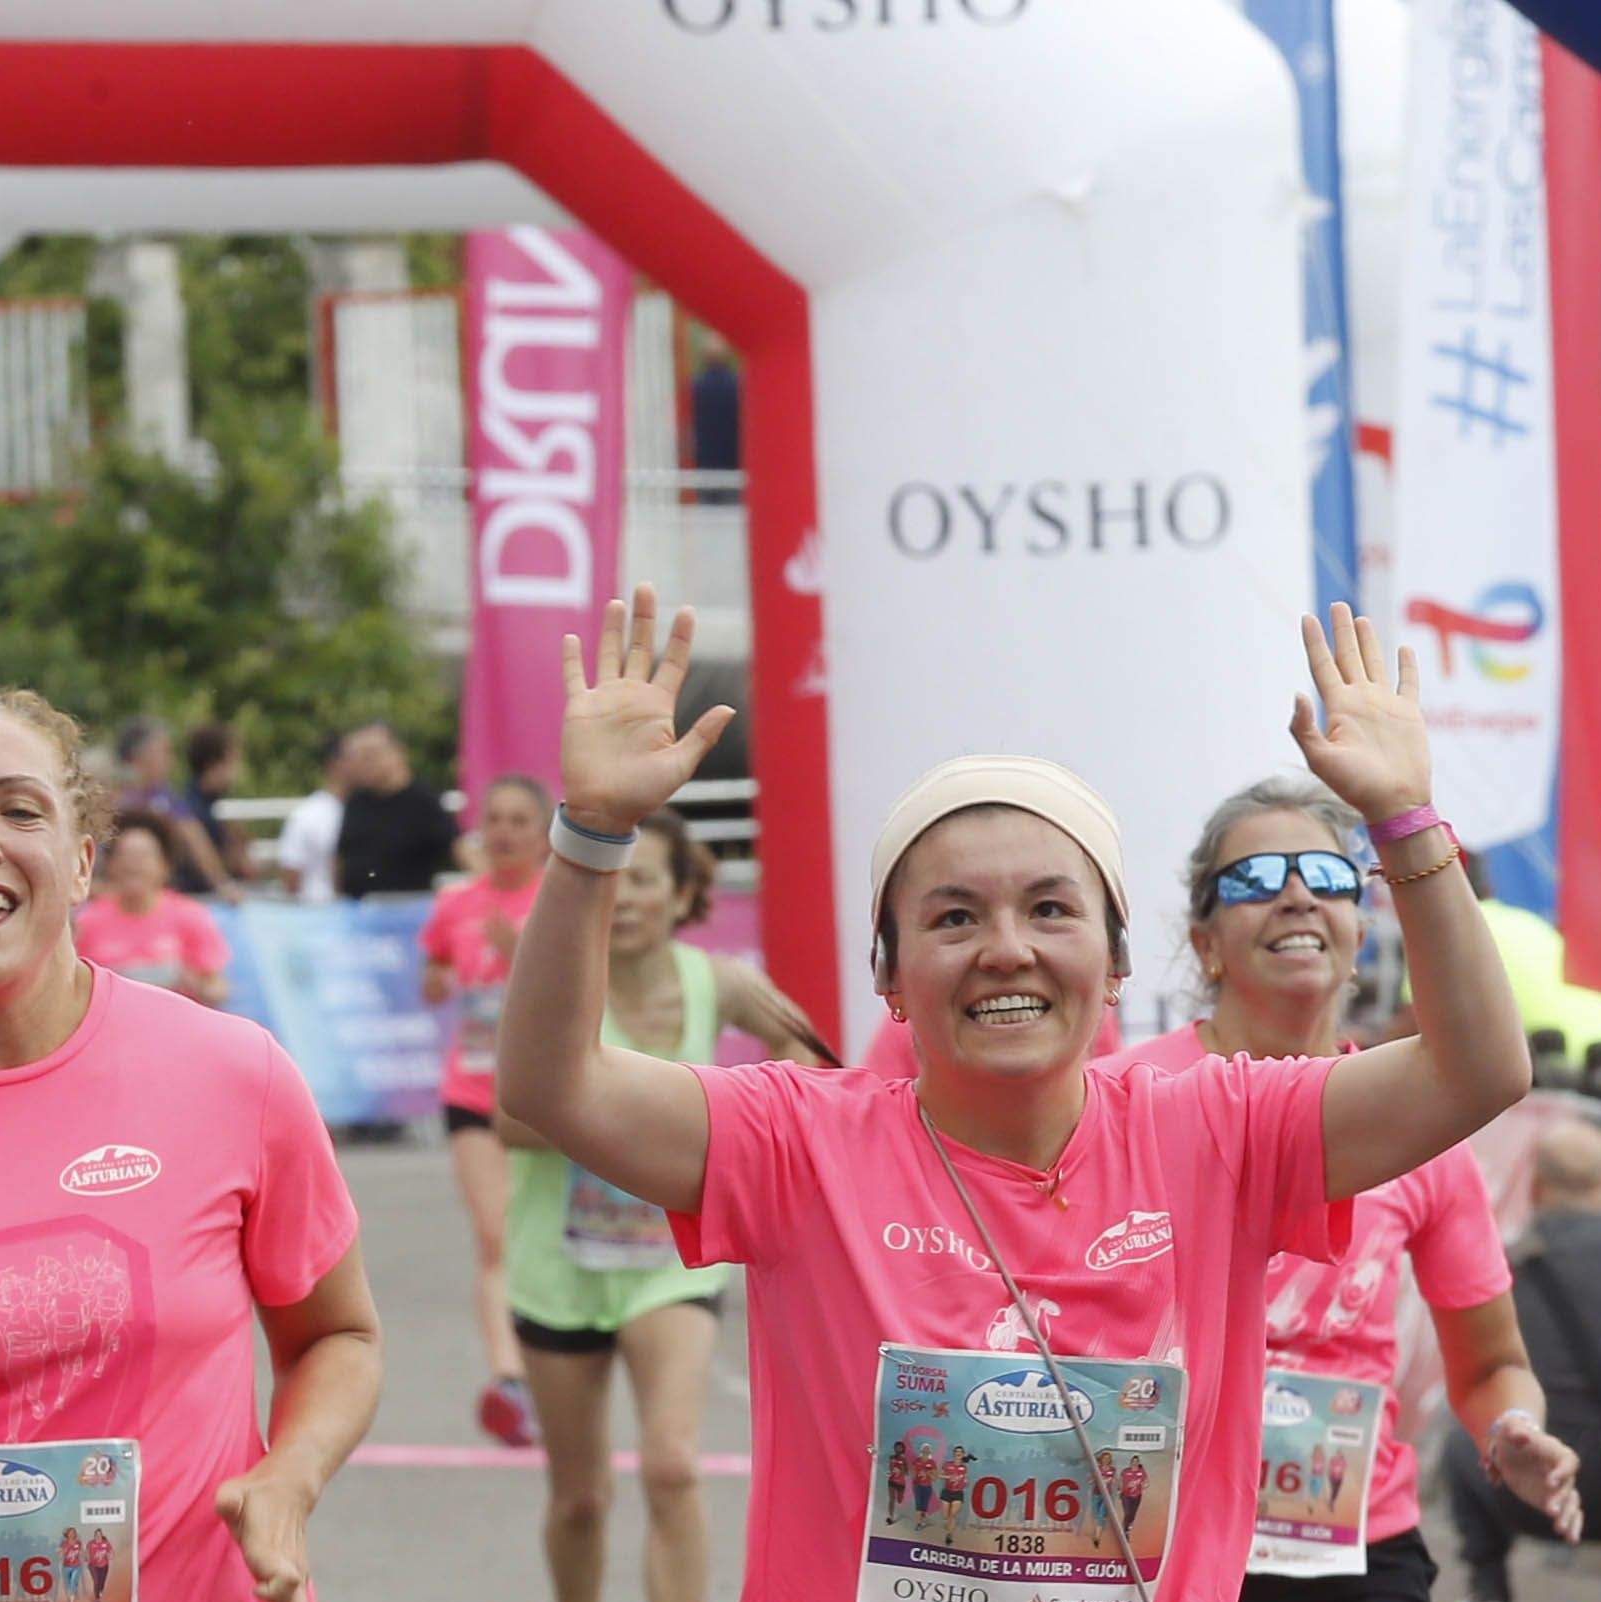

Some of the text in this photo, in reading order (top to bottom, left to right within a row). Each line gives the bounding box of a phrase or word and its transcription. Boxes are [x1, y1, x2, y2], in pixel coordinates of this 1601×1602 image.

[888, 473, 1232, 562] OYSHO
[896, 1374, 947, 1393] SUMA
[1258, 1458, 1303, 1495] 16
[971, 1476, 1081, 1522] 016
[994, 1534, 1046, 1555] 1838
[909, 1547, 976, 1572] CARRERA
[979, 1559, 999, 1574] DE
[1002, 1561, 1022, 1577] LA
[1025, 1562, 1072, 1577] MUJER
[1085, 1559, 1128, 1578] GIJÓN
